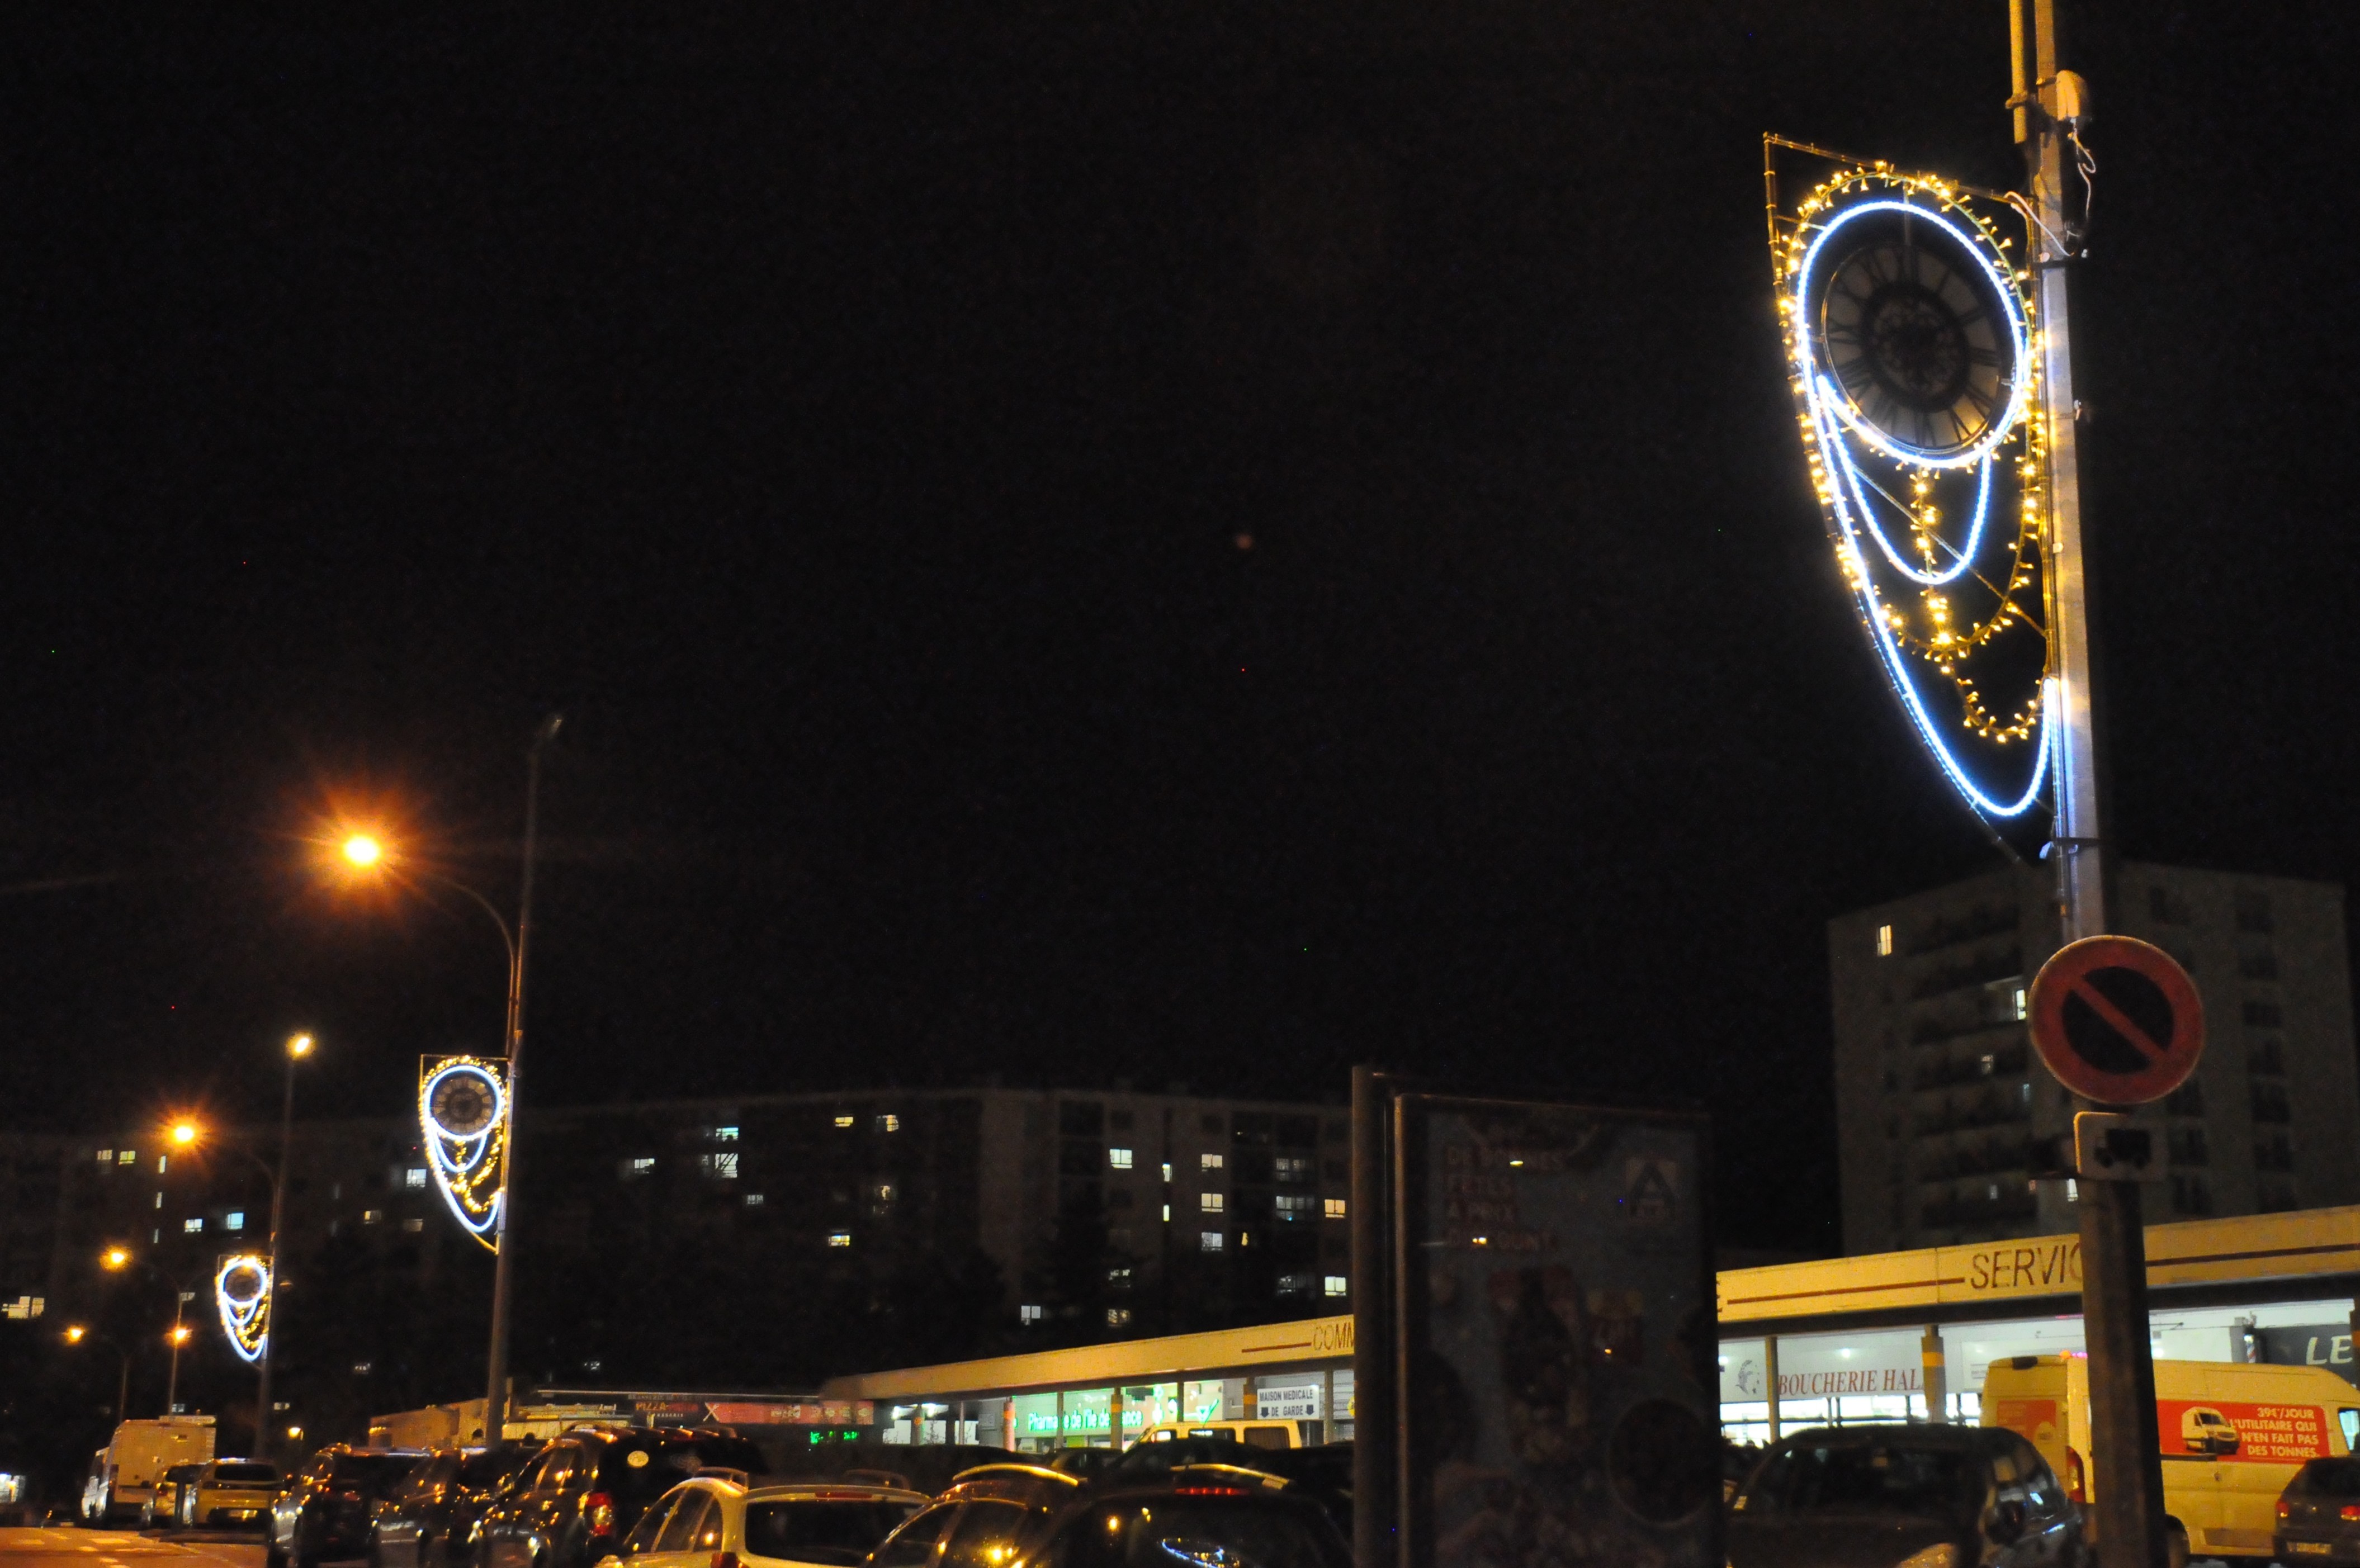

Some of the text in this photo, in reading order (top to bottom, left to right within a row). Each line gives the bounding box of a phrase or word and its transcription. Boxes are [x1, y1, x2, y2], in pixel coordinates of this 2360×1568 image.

[1779, 1369, 1878, 1396] BOUCHERIE
[1259, 1390, 1313, 1402] MAISON MEDICALE
[1271, 1405, 1304, 1417] DE GARDE
[1028, 1412, 1071, 1432] Pharmae
[2295, 1420, 2318, 1432] QUI
[2241, 1431, 2319, 1446] N'EN FAIT PAS
[2247, 1444, 2268, 1456] DES
